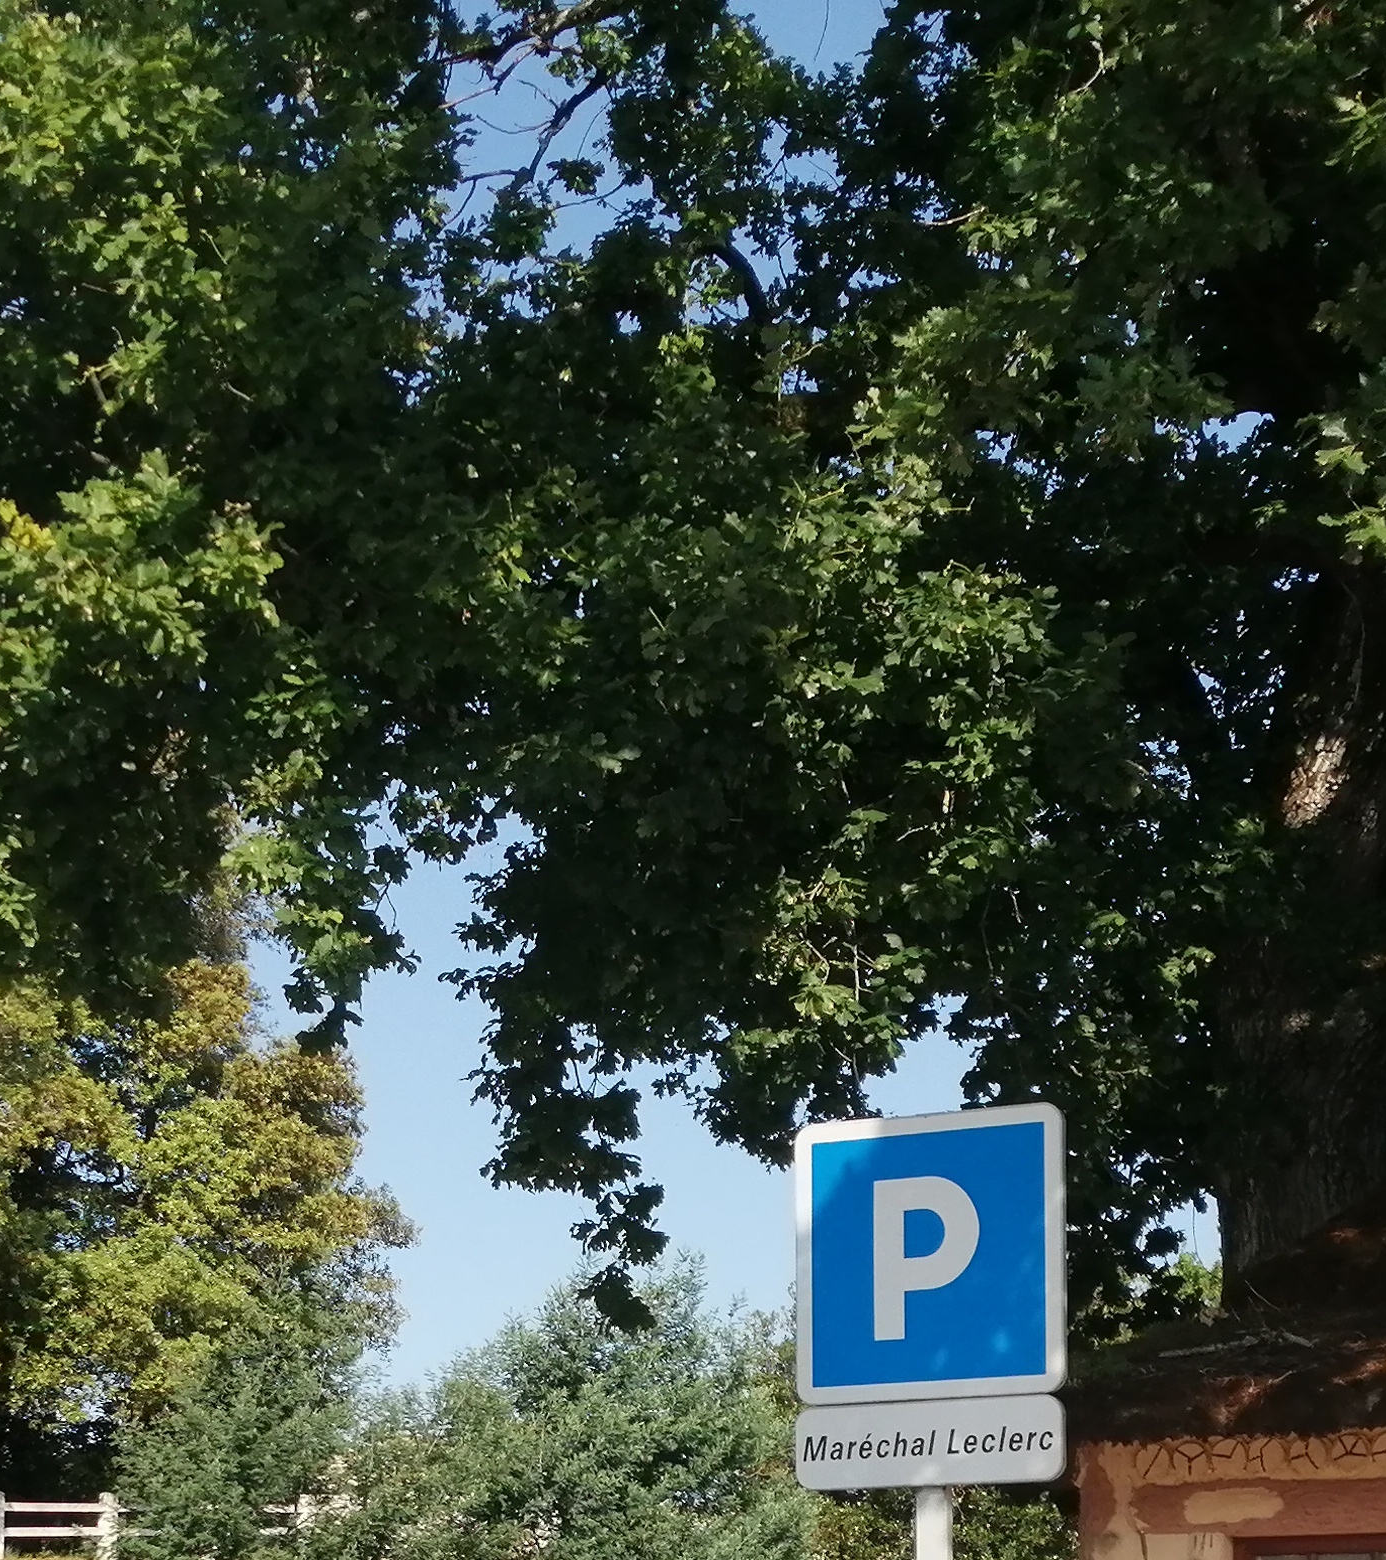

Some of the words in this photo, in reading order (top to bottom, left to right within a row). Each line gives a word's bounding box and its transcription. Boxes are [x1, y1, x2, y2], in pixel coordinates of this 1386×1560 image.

[873, 1175, 980, 1342] P
[802, 1430, 936, 1462] Maréchal
[946, 1426, 1055, 1455] Leclerc
